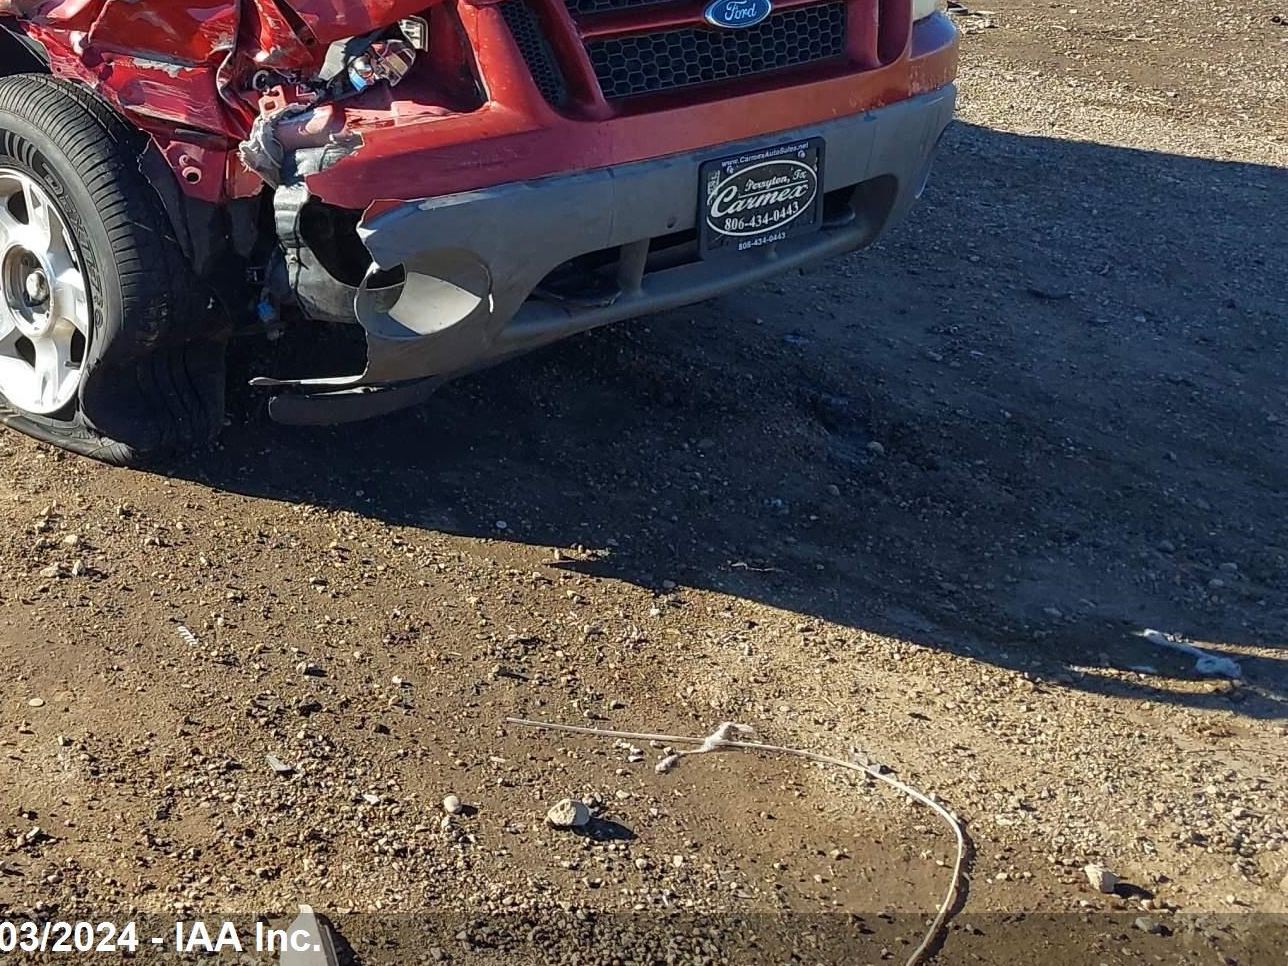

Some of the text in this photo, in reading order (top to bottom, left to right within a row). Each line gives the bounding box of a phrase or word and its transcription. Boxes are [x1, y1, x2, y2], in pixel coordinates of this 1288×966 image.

[724, 0, 757, 21] Ford
[744, 175, 790, 192] Perryton,
[711, 183, 809, 218] Carmex
[724, 201, 799, 231] 806-434-0443
